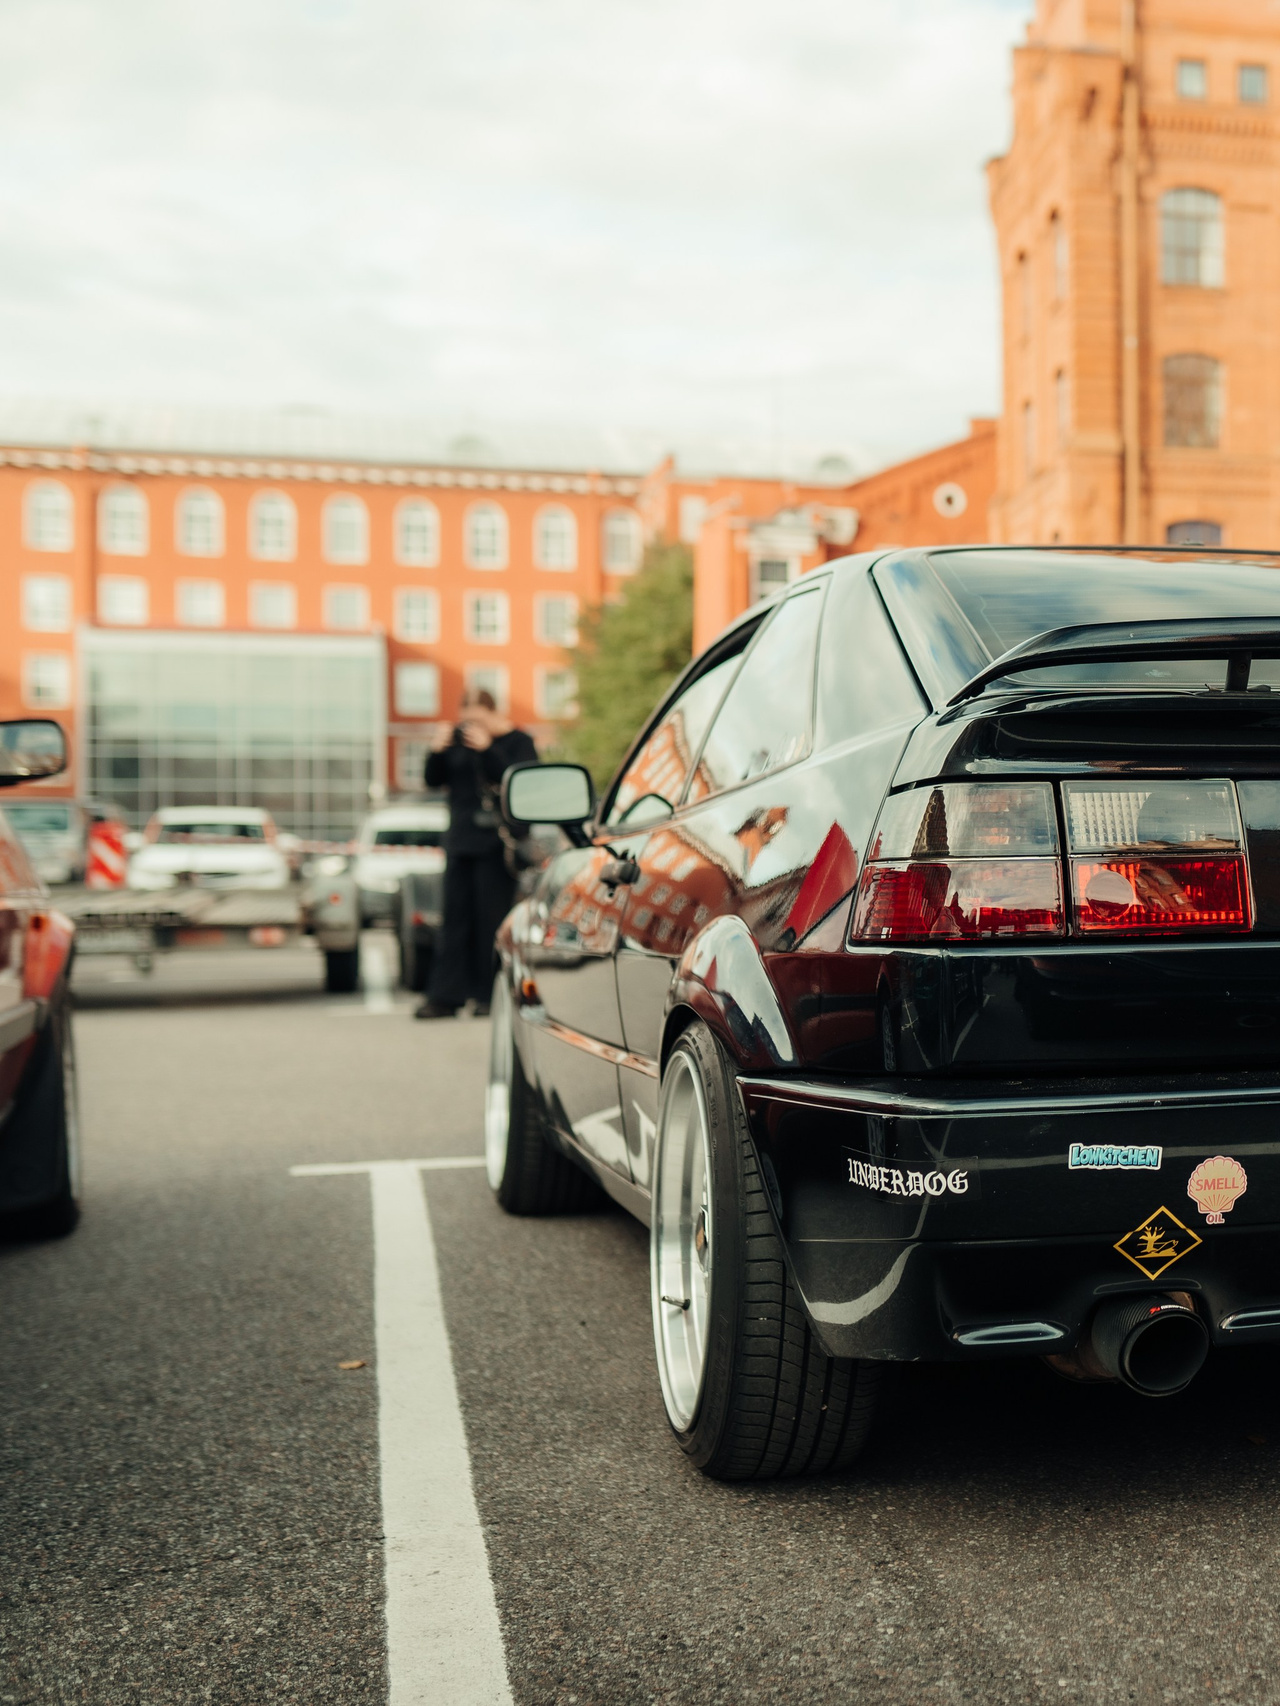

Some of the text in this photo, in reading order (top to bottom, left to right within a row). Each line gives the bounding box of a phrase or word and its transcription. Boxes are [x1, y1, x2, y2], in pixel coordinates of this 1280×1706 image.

[847, 1158, 969, 1197] UNDERDOG
[1195, 1177, 1240, 1192] SMELL
[1207, 1214, 1225, 1224] OIL
